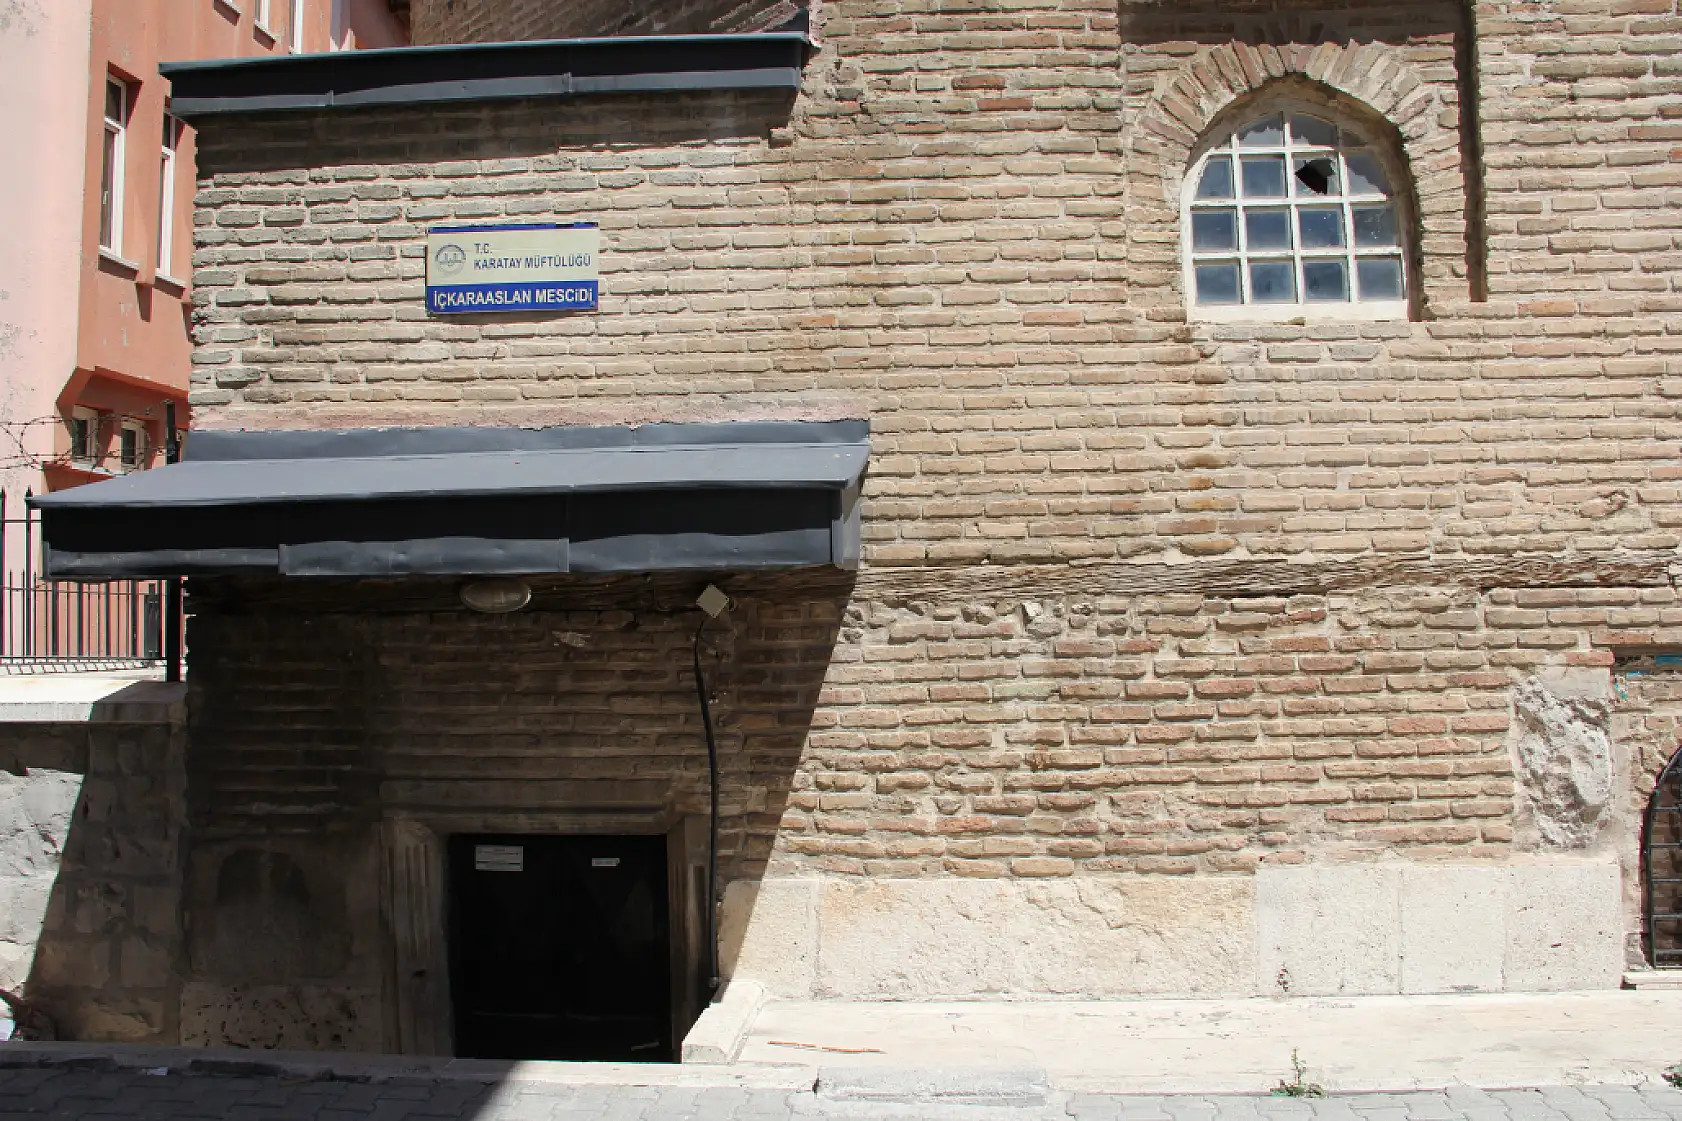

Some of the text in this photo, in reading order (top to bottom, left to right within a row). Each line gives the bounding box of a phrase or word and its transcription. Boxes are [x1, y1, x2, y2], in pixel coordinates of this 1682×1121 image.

[473, 242, 492, 254] T.C.
[473, 253, 591, 271] KARATAY MÜFTÜLÜĞÜ
[434, 288, 532, 310] İÇKARAASLAN
